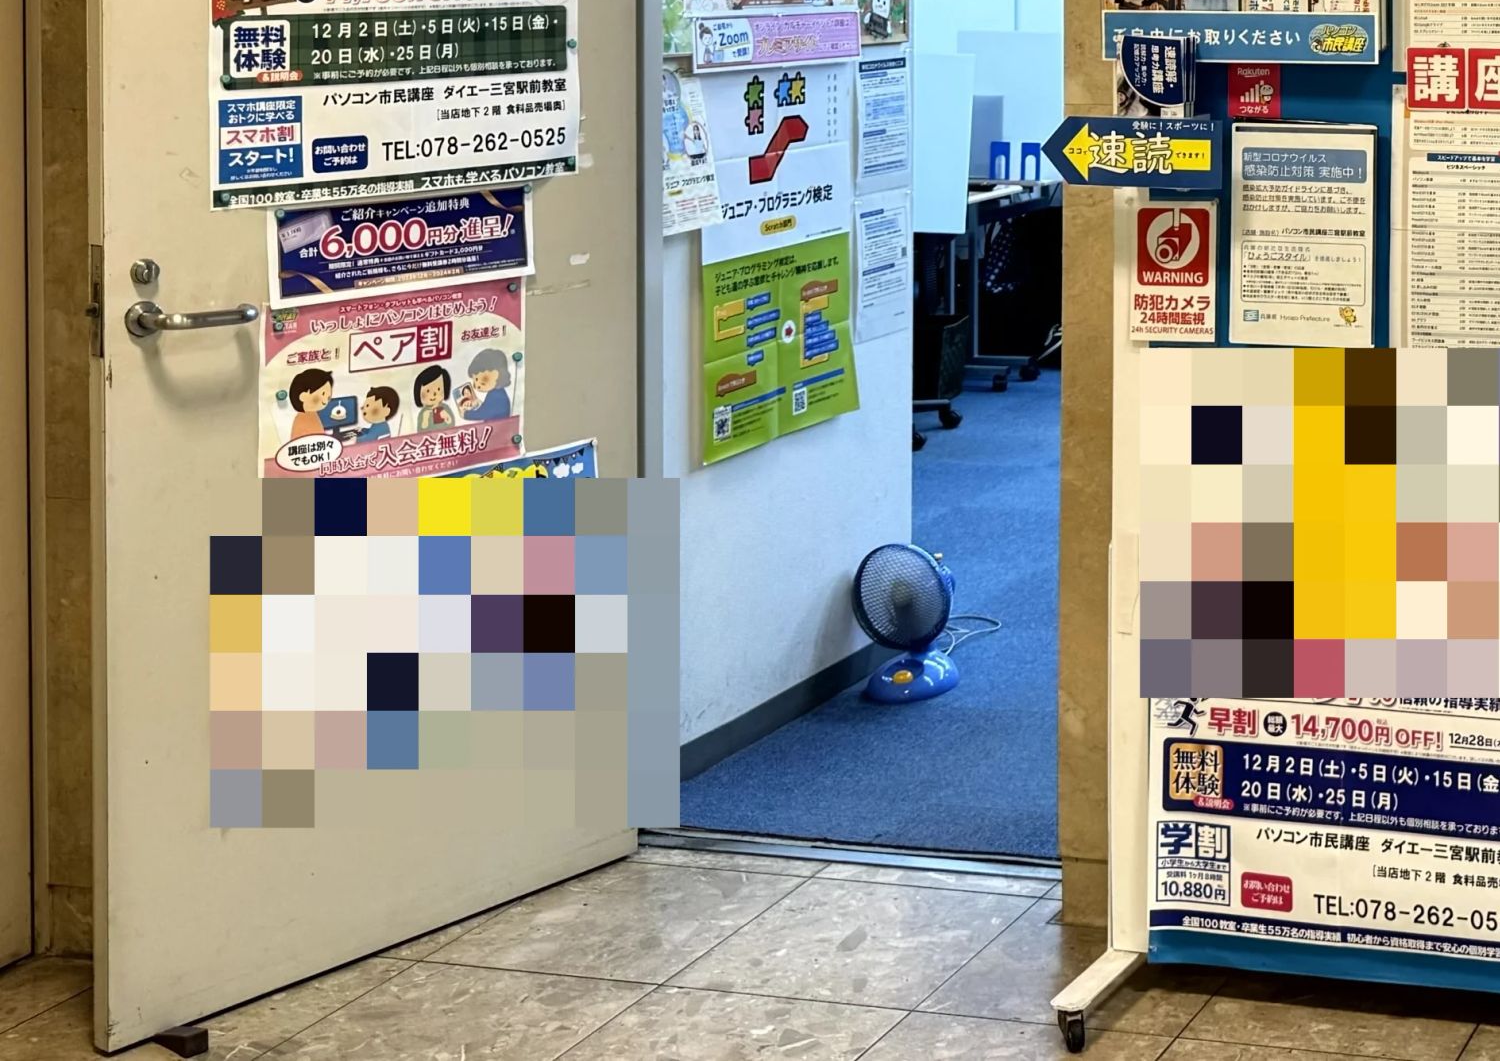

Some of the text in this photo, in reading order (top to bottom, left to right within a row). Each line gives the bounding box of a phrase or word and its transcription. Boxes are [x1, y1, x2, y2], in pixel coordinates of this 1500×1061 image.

[234, 25, 286, 47] 無料
[719, 31, 748, 46] Zoom
[1323, 24, 1358, 37] パソコン
[1322, 36, 1368, 54] 市民講座
[234, 48, 286, 73] 体験
[1151, 45, 1164, 94] 思考力講座
[1237, 67, 1270, 76] Rakuten
[323, 78, 567, 106] パソコン市民講座 ダイエー三宮駅前教室
[228, 100, 296, 112] スマホ講座限定
[1240, 106, 1269, 114] つながる
[229, 111, 295, 122] おトクに学べる
[226, 125, 294, 145] スマホ割
[315, 143, 366, 154] お問い合わせ
[382, 127, 566, 162] TEL:078-262-0525
[1088, 131, 1172, 175] 速読
[229, 149, 294, 167] スタート!
[324, 157, 357, 166] ご予約は
[1244, 152, 1326, 162] 新型コロナウイルス
[1244, 165, 1362, 179] 感染防止対策 実施中!
[341, 197, 470, 221] ご紹介キャンペーン追加特典
[721, 185, 833, 219] ジュニア・プログラミング検定
[300, 247, 317, 258] 合計
[1142, 271, 1204, 284] WARNING
[1134, 294, 1211, 311] 防犯カメラ
[1140, 312, 1205, 326] 24時間監視
[461, 326, 507, 342] お友達と!
[1145, 326, 1177, 334] SECURITY
[1180, 327, 1214, 335] CAMERAS
[353, 325, 450, 362] ペア割
[286, 347, 339, 366] ご家族と!
[288, 436, 335, 455] 講座は別々
[1208, 707, 1259, 736] 早割
[1291, 713, 1390, 745] 14,700円
[1395, 728, 1443, 751] OFF!
[1267, 724, 1283, 733] 最大
[1174, 748, 1220, 772] 無料
[1173, 771, 1221, 797] 体験
[1160, 823, 1229, 859] 学割
[1256, 827, 1370, 852] パソコン市民講座
[1160, 858, 1227, 870] 小学生から大学生まで
[1161, 880, 1226, 902] 10,880円
[1243, 879, 1291, 895] お問い合わせ
[1251, 892, 1284, 905] ご予約は
